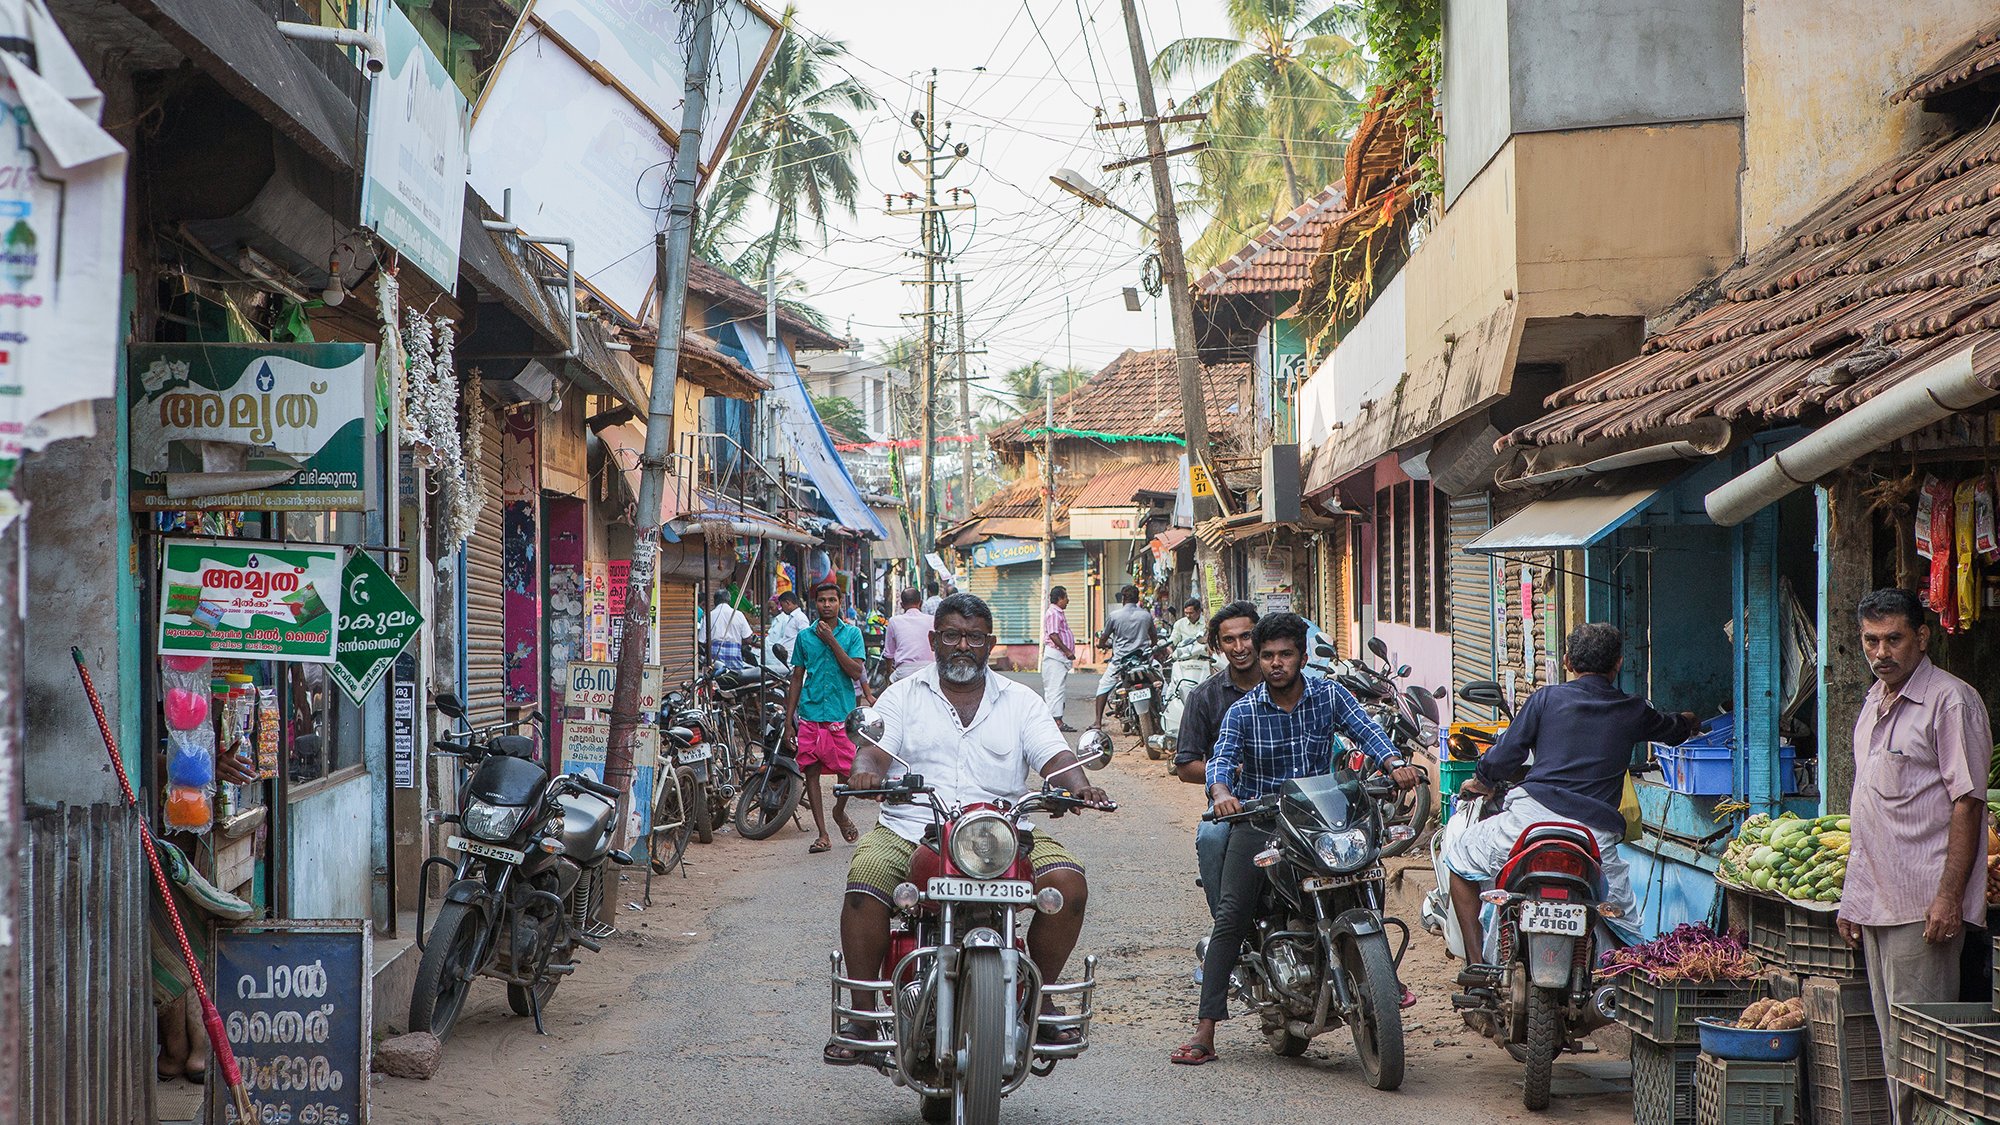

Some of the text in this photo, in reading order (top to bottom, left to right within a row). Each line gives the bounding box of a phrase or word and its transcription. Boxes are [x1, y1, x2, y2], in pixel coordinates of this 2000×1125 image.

[160, 380, 328, 444] അമൃത്
[299, 469, 359, 488] ലഭിക്കുന്നു
[1003, 544, 1037, 559] SALOON
[202, 567, 305, 598] അമൃത്
[285, 630, 329, 644] തൈര്
[457, 841, 467, 850] KL
[1536, 907, 1571, 919] KL 54
[1529, 917, 1577, 931] F 4160
[237, 959, 327, 1000] പാൽ
[226, 1003, 335, 1044] തൈര്
